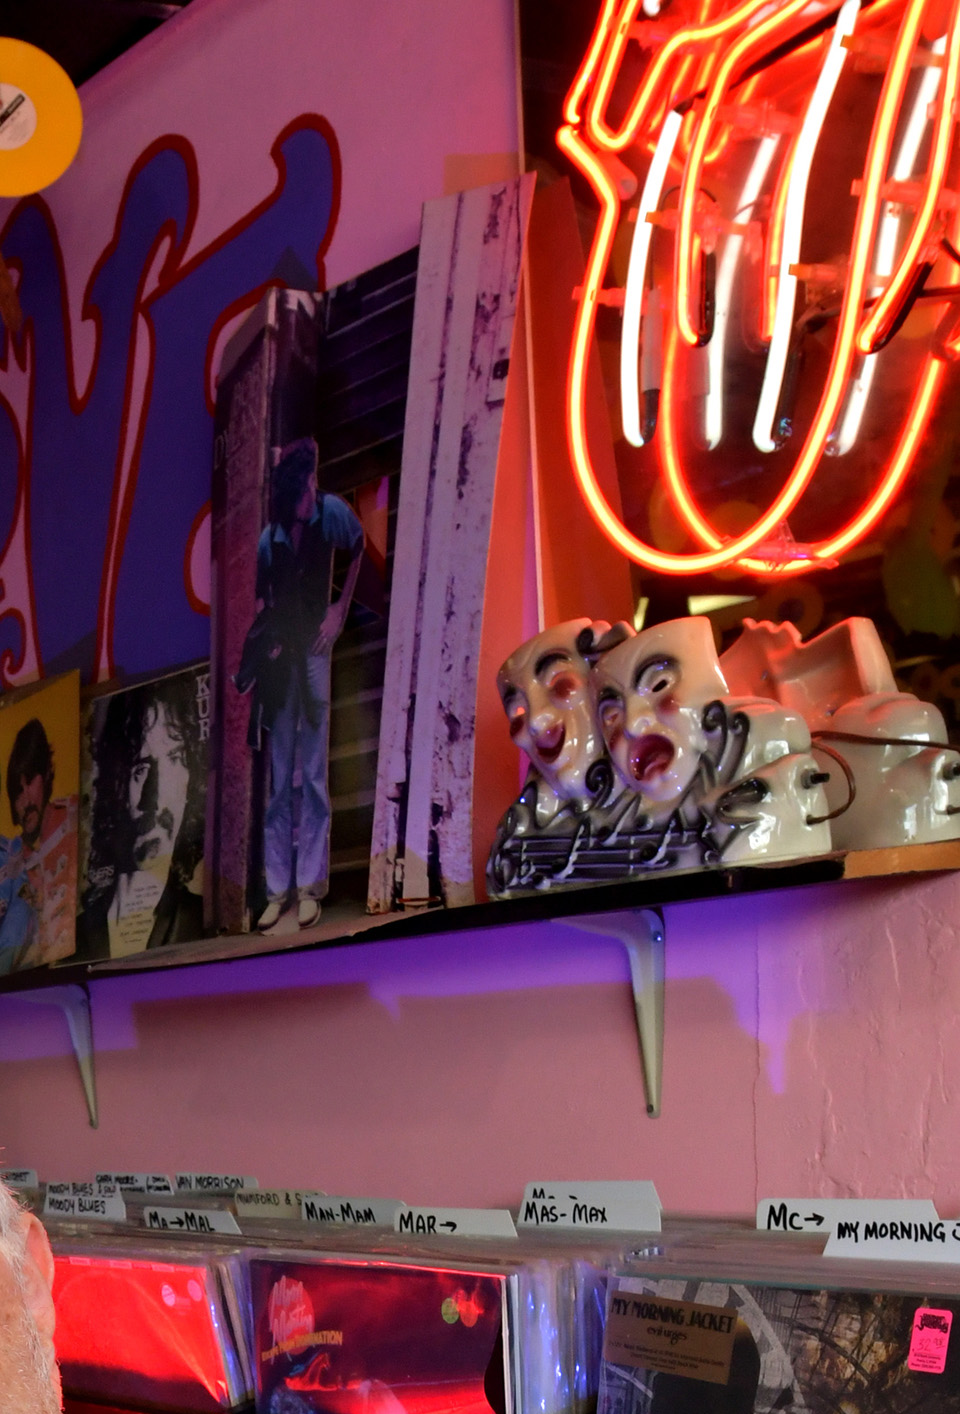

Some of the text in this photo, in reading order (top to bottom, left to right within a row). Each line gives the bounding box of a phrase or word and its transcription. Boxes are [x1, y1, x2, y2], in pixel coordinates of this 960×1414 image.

[195, 1176, 244, 1190] MORRISON
[49, 1199, 106, 1219] MOODY BLUES
[399, 1210, 437, 1234] MAR
[837, 1222, 861, 1241] MY
[865, 1221, 947, 1243] MORNING
[611, 1297, 735, 1334] MY MORNING JACKET
